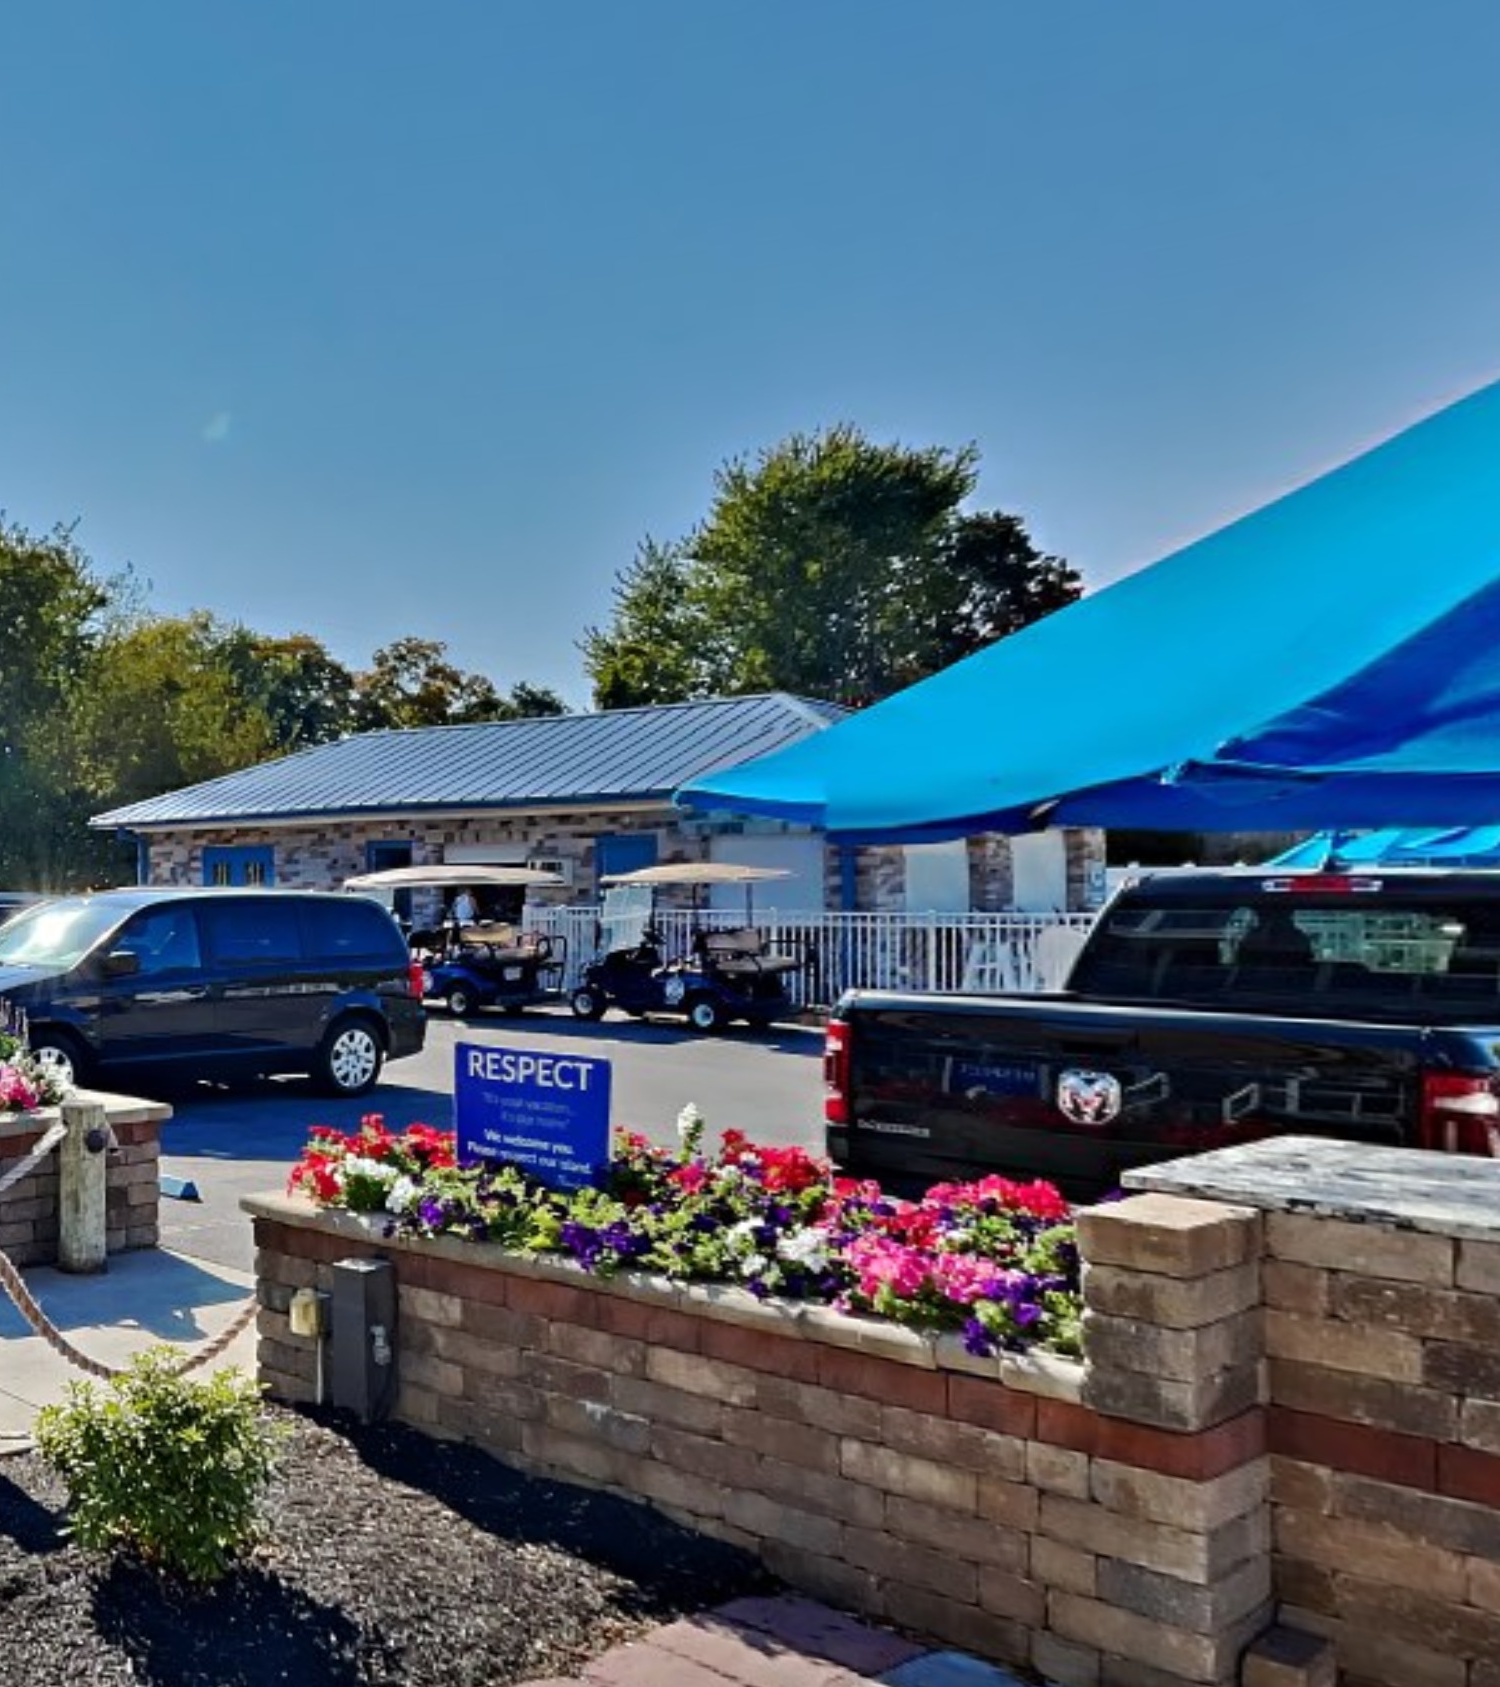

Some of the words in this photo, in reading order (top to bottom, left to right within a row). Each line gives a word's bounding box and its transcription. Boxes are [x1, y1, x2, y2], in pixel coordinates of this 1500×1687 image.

[468, 1050, 593, 1091] RESPECT
[484, 1128, 502, 1143] We
[503, 1135, 549, 1151] welcome
